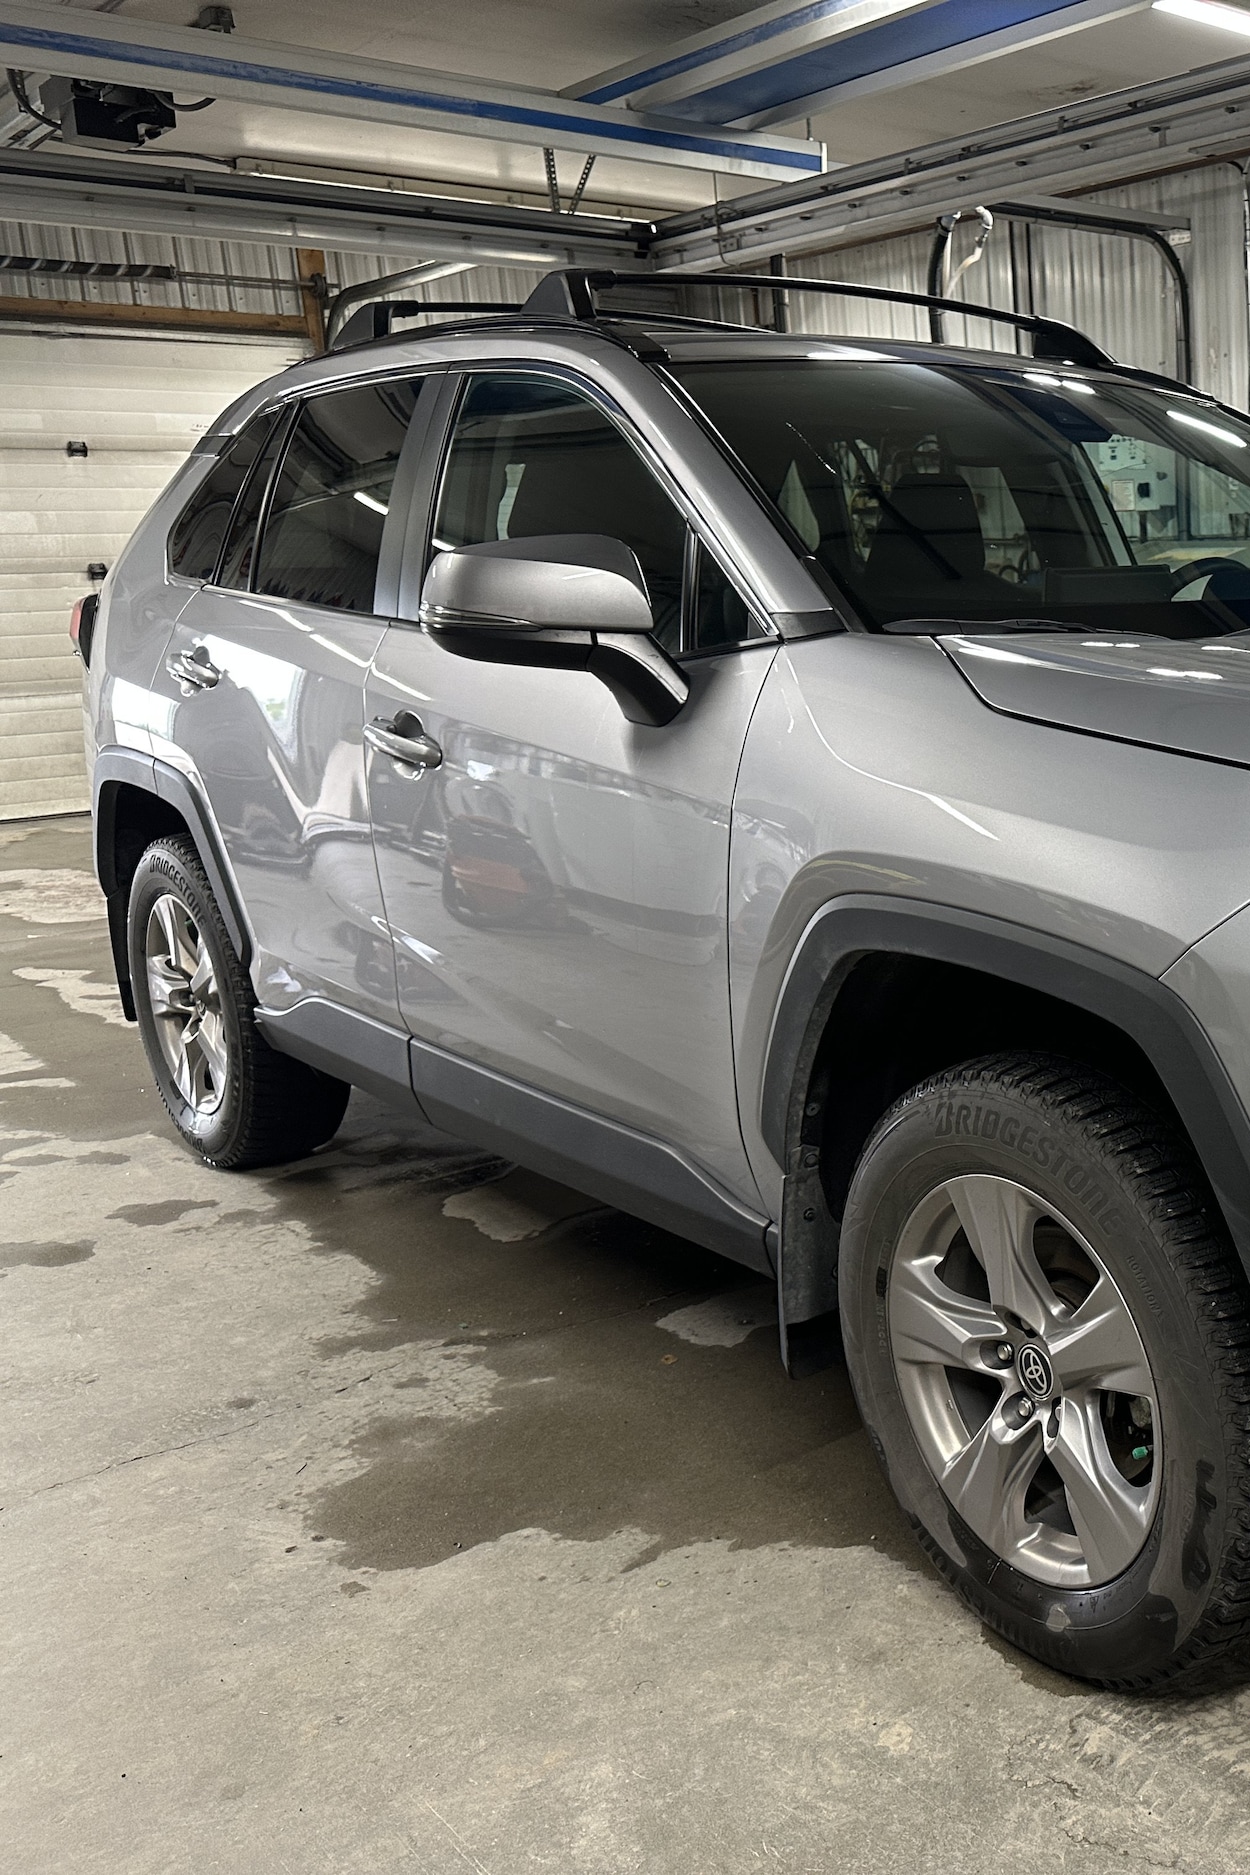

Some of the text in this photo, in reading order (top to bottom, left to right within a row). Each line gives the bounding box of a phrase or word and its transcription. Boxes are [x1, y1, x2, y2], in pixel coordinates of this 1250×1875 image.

[150, 854, 206, 926] BRIDGESTONE
[934, 1099, 1126, 1236] BRIDGESTONE
[1126, 1255, 1161, 1313] ROTATION
